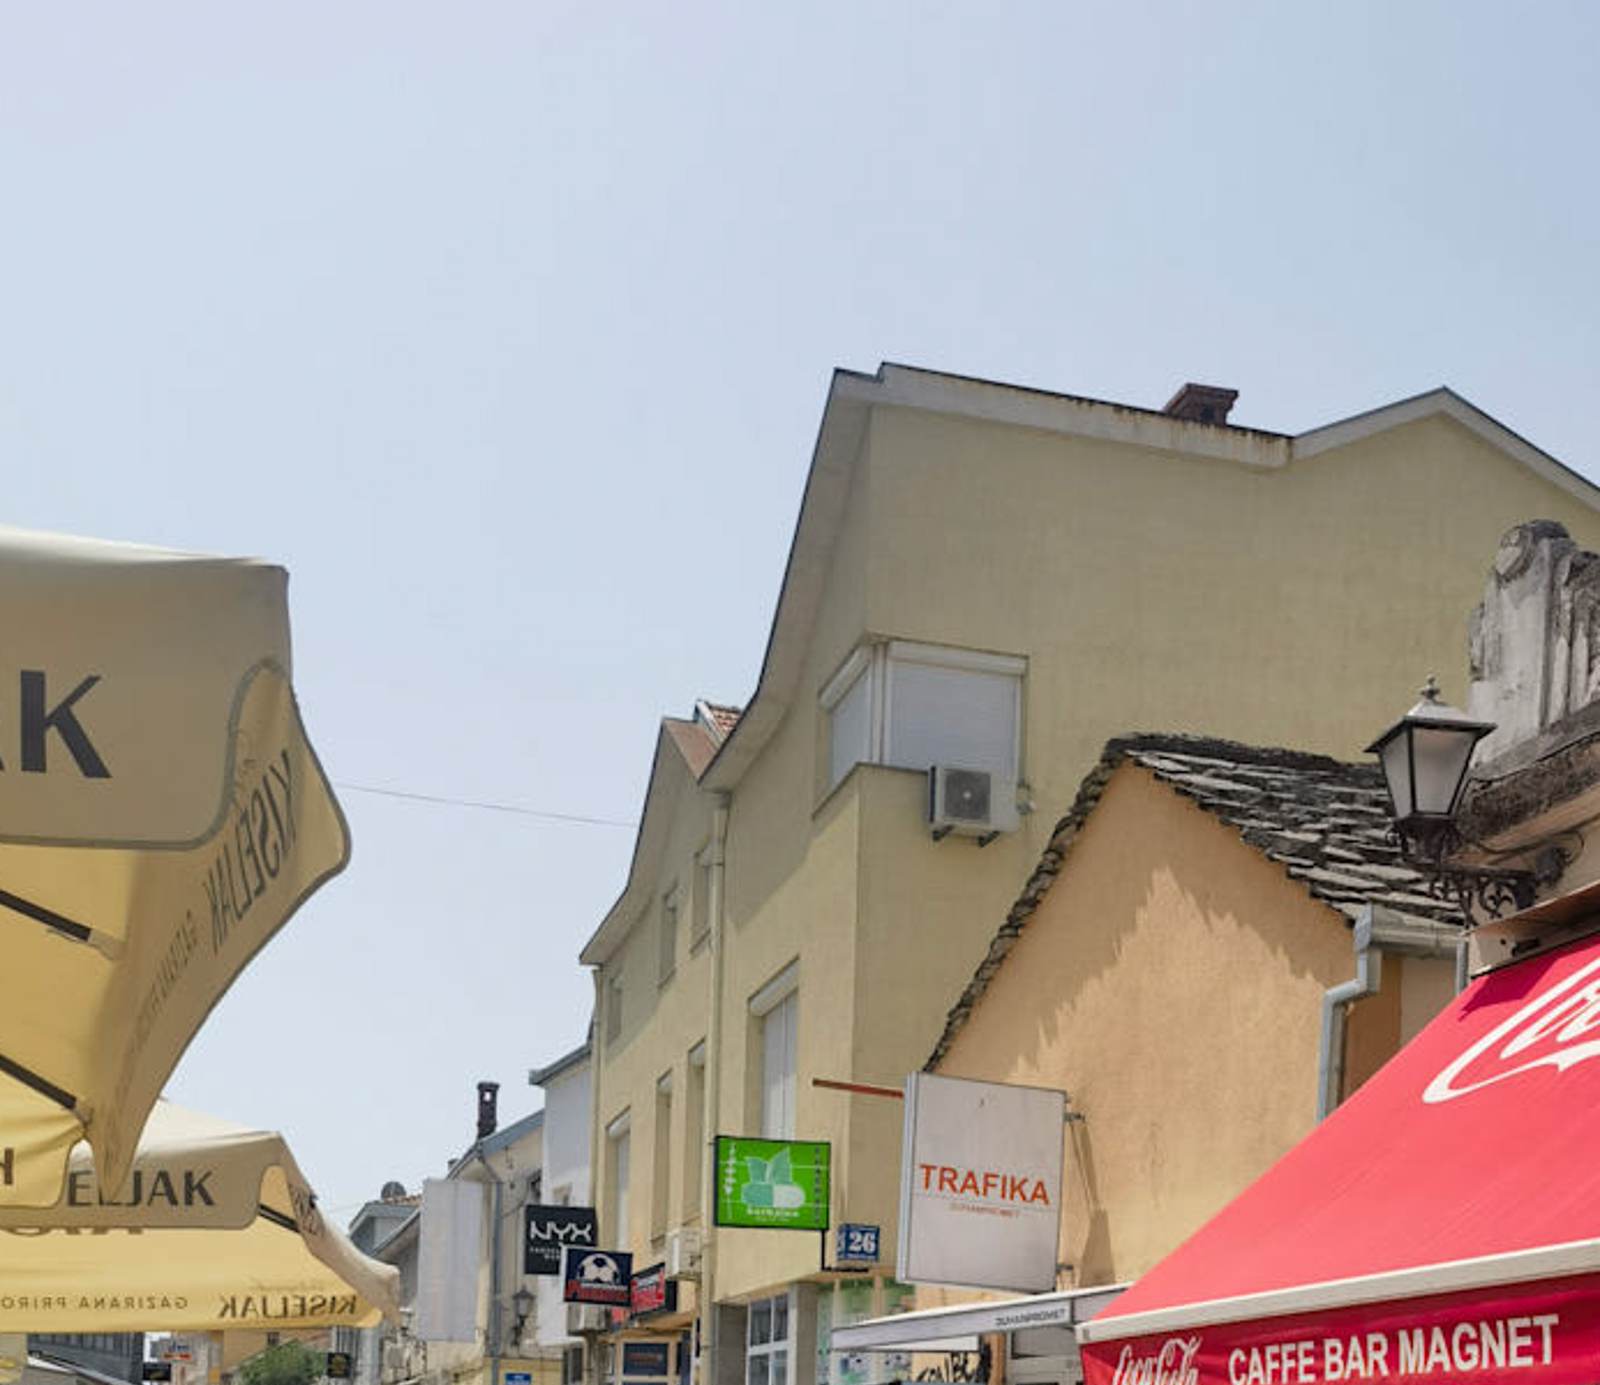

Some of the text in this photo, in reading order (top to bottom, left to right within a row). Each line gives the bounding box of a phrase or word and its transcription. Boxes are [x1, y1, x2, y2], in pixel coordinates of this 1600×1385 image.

[0, 669, 113, 780] K
[68, 1170, 215, 1207] ELJAK
[921, 1164, 1050, 1206] TRAFIKA
[530, 1221, 592, 1242] NYX
[849, 1232, 875, 1252] 26
[1323, 1333, 1391, 1382] BAR
[1398, 1314, 1560, 1376] MAGNET
